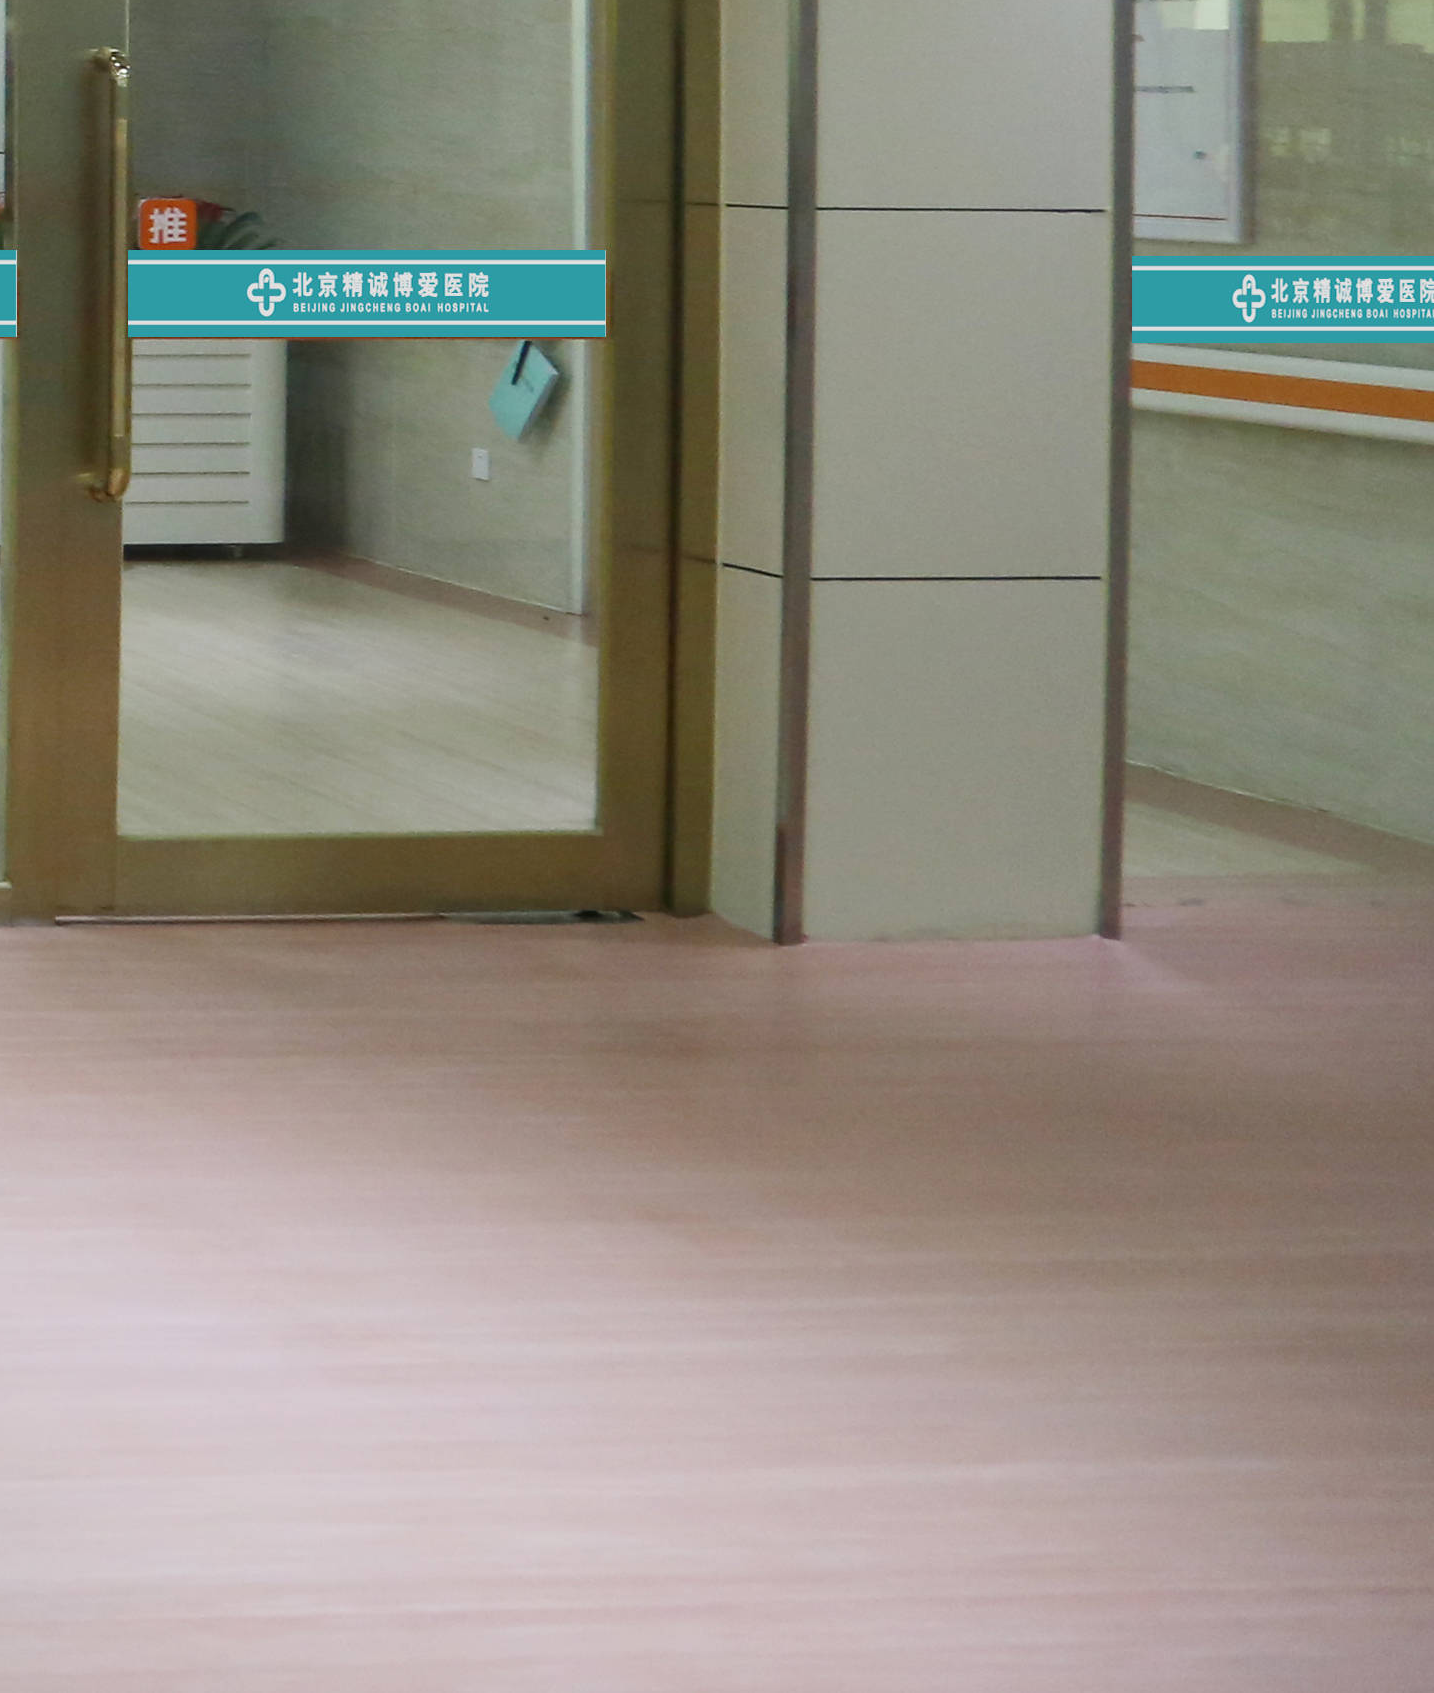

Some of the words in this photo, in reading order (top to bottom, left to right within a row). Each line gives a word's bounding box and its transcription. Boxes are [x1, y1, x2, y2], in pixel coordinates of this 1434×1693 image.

[148, 207, 187, 244] 推
[292, 271, 490, 298] 北京精诚博爱医院
[1271, 277, 1434, 303] 北京精诚博爱医院
[293, 302, 336, 313] BEIJING
[340, 302, 402, 313] JINGCHENG
[405, 302, 431, 313] BOAI
[437, 302, 490, 313] HOSPITAL
[1272, 308, 1308, 319] BEIJING
[1311, 308, 1363, 319] JINGCHENG
[1365, 308, 1389, 319] BOAI
